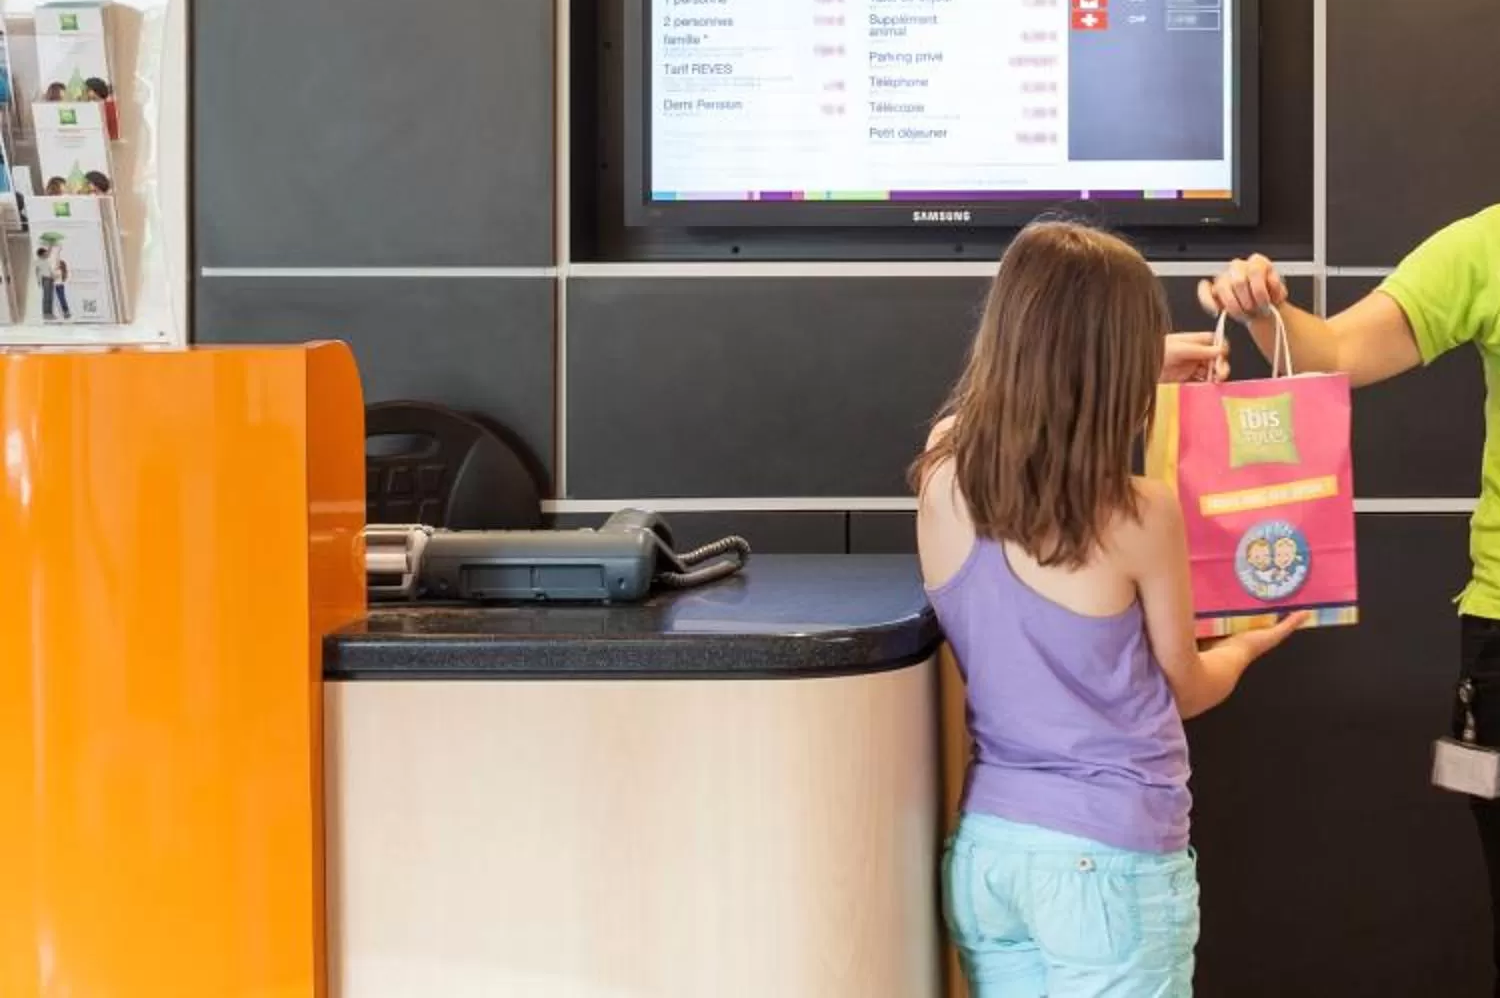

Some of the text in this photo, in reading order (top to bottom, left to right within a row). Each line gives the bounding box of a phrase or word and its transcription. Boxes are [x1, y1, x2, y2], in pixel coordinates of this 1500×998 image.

[663, 16, 734, 29] 2 personnes
[913, 211, 971, 221] SAMSUNG
[1239, 407, 1281, 431] ibis
